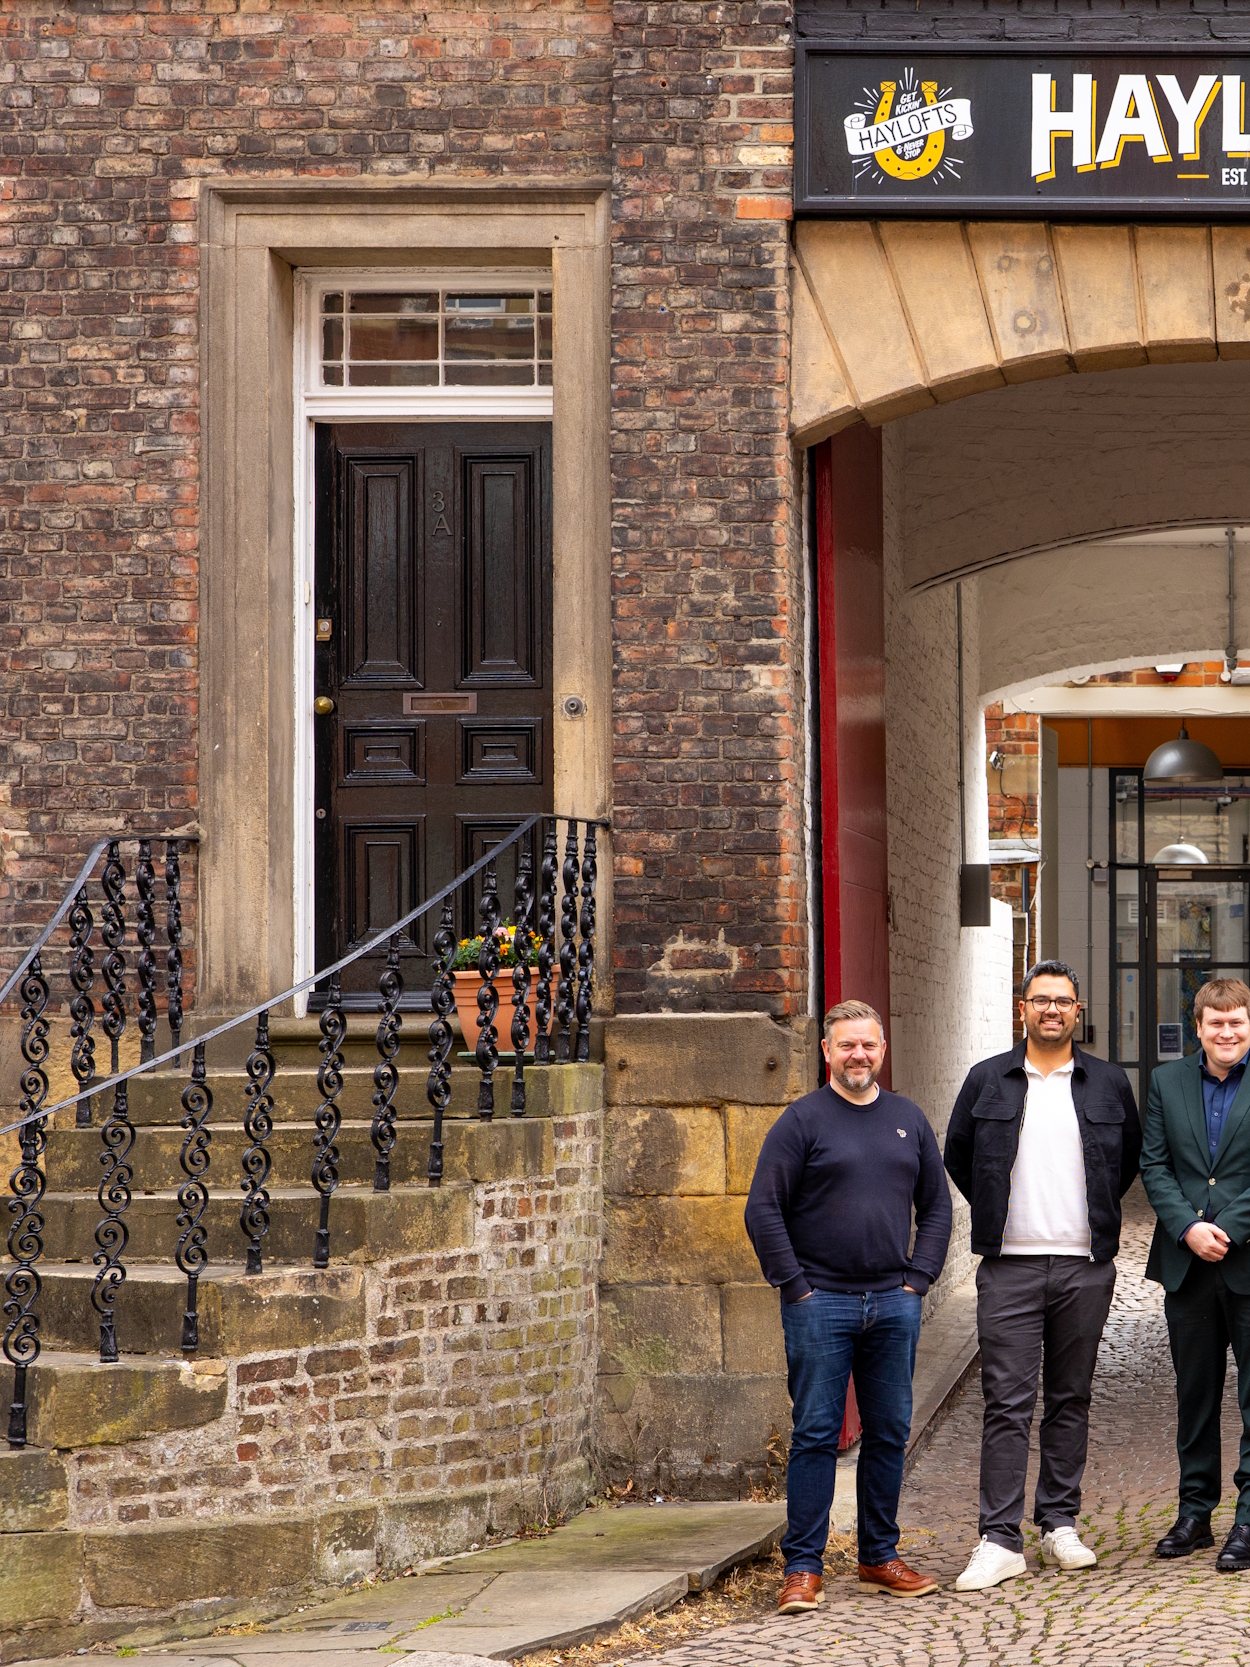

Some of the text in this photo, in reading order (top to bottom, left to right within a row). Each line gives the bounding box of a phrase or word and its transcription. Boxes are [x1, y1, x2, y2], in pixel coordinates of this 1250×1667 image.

[895, 97, 922, 116] KICKIN'
[900, 91, 918, 105] GET
[859, 103, 957, 151] HAYLOFTS
[896, 138, 925, 155] & NEVER
[904, 148, 921, 160] STOP
[1221, 168, 1248, 186] EST.
[432, 490, 445, 513] 3
[431, 513, 453, 536] A
